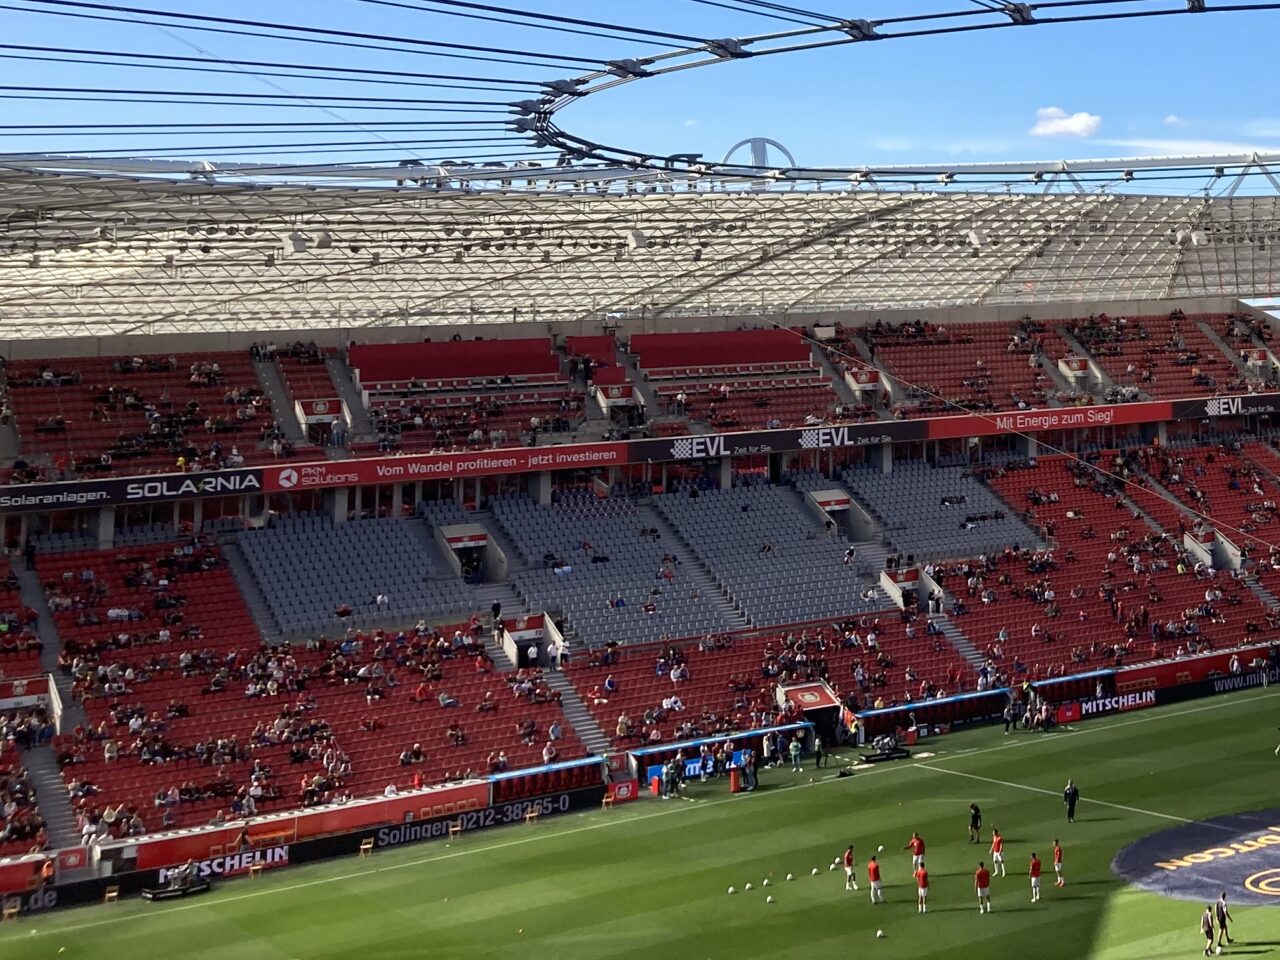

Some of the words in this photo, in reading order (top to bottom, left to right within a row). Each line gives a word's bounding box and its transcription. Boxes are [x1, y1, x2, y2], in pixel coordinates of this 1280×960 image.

[996, 416, 1013, 430] Mit
[1017, 413, 1059, 428] Energie
[1061, 413, 1085, 424] zum
[1087, 409, 1114, 425] Sieg!
[692, 436, 731, 458] EVL
[818, 427, 854, 447] EVL
[302, 467, 326, 476] PKM
[376, 465, 404, 477] Vom
[408, 461, 453, 475] Wandel
[457, 456, 517, 472] profitieren
[528, 453, 553, 467] jetzt
[556, 450, 617, 463] investieren
[126, 474, 260, 499] SOLARNIA
[302, 472, 359, 486] solutions
[0, 491, 111, 507] Solaranlagen.
[1081, 690, 1156, 714] MITSCHELIN
